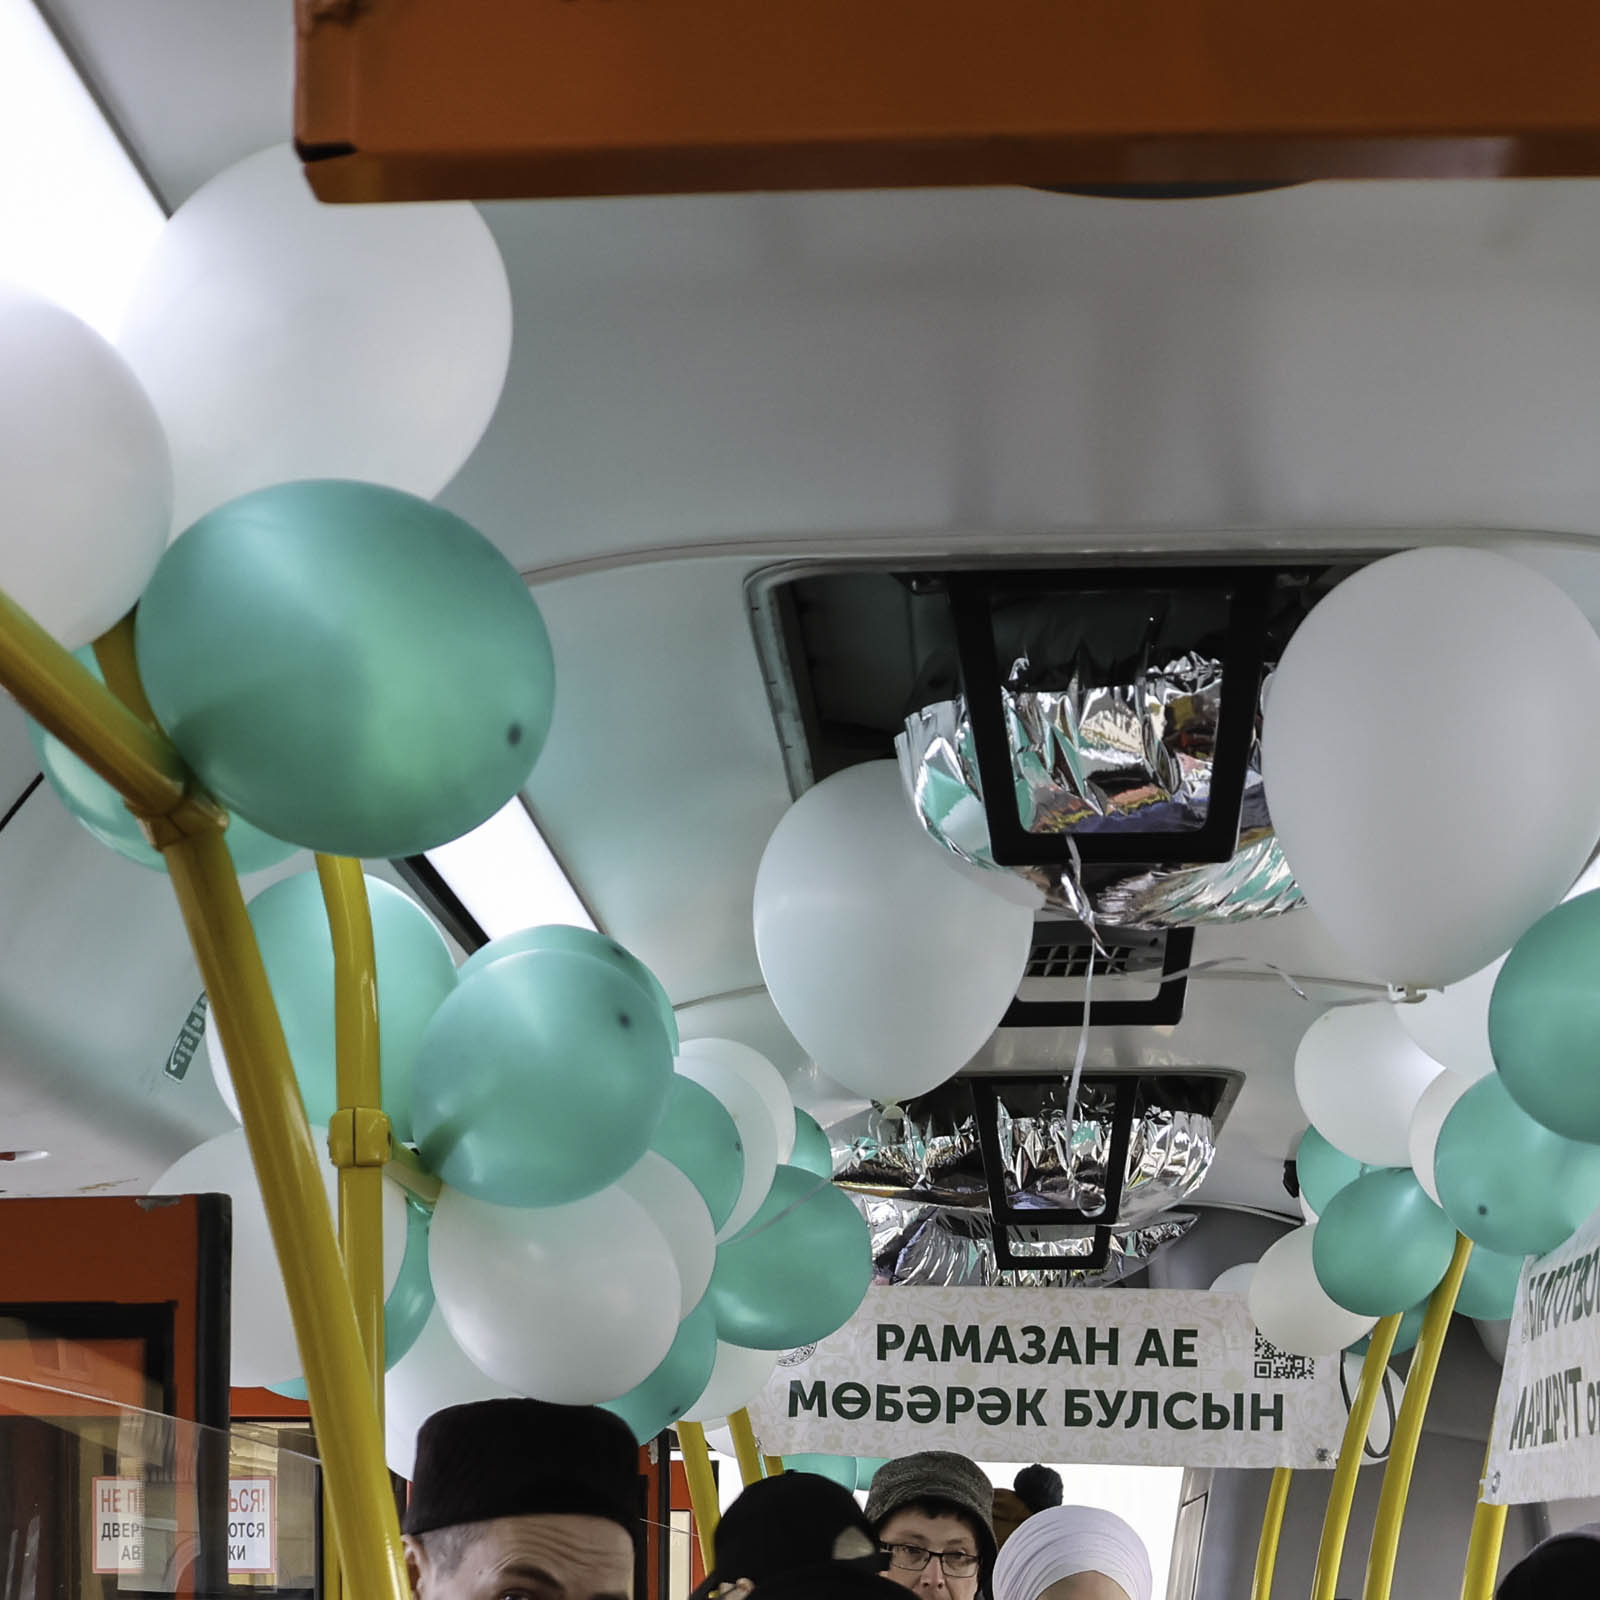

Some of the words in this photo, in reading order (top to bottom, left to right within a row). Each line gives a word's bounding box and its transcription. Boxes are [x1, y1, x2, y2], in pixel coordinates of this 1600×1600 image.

[876, 1323, 1119, 1367] РАМАЗАН
[1135, 1328, 1199, 1368] АЕ
[788, 1380, 1048, 1427] МӨБӘРӘК
[1063, 1388, 1285, 1432] БУЛСЫН
[101, 1487, 121, 1513] НЕ
[101, 1522, 144, 1541] ДВЕР
